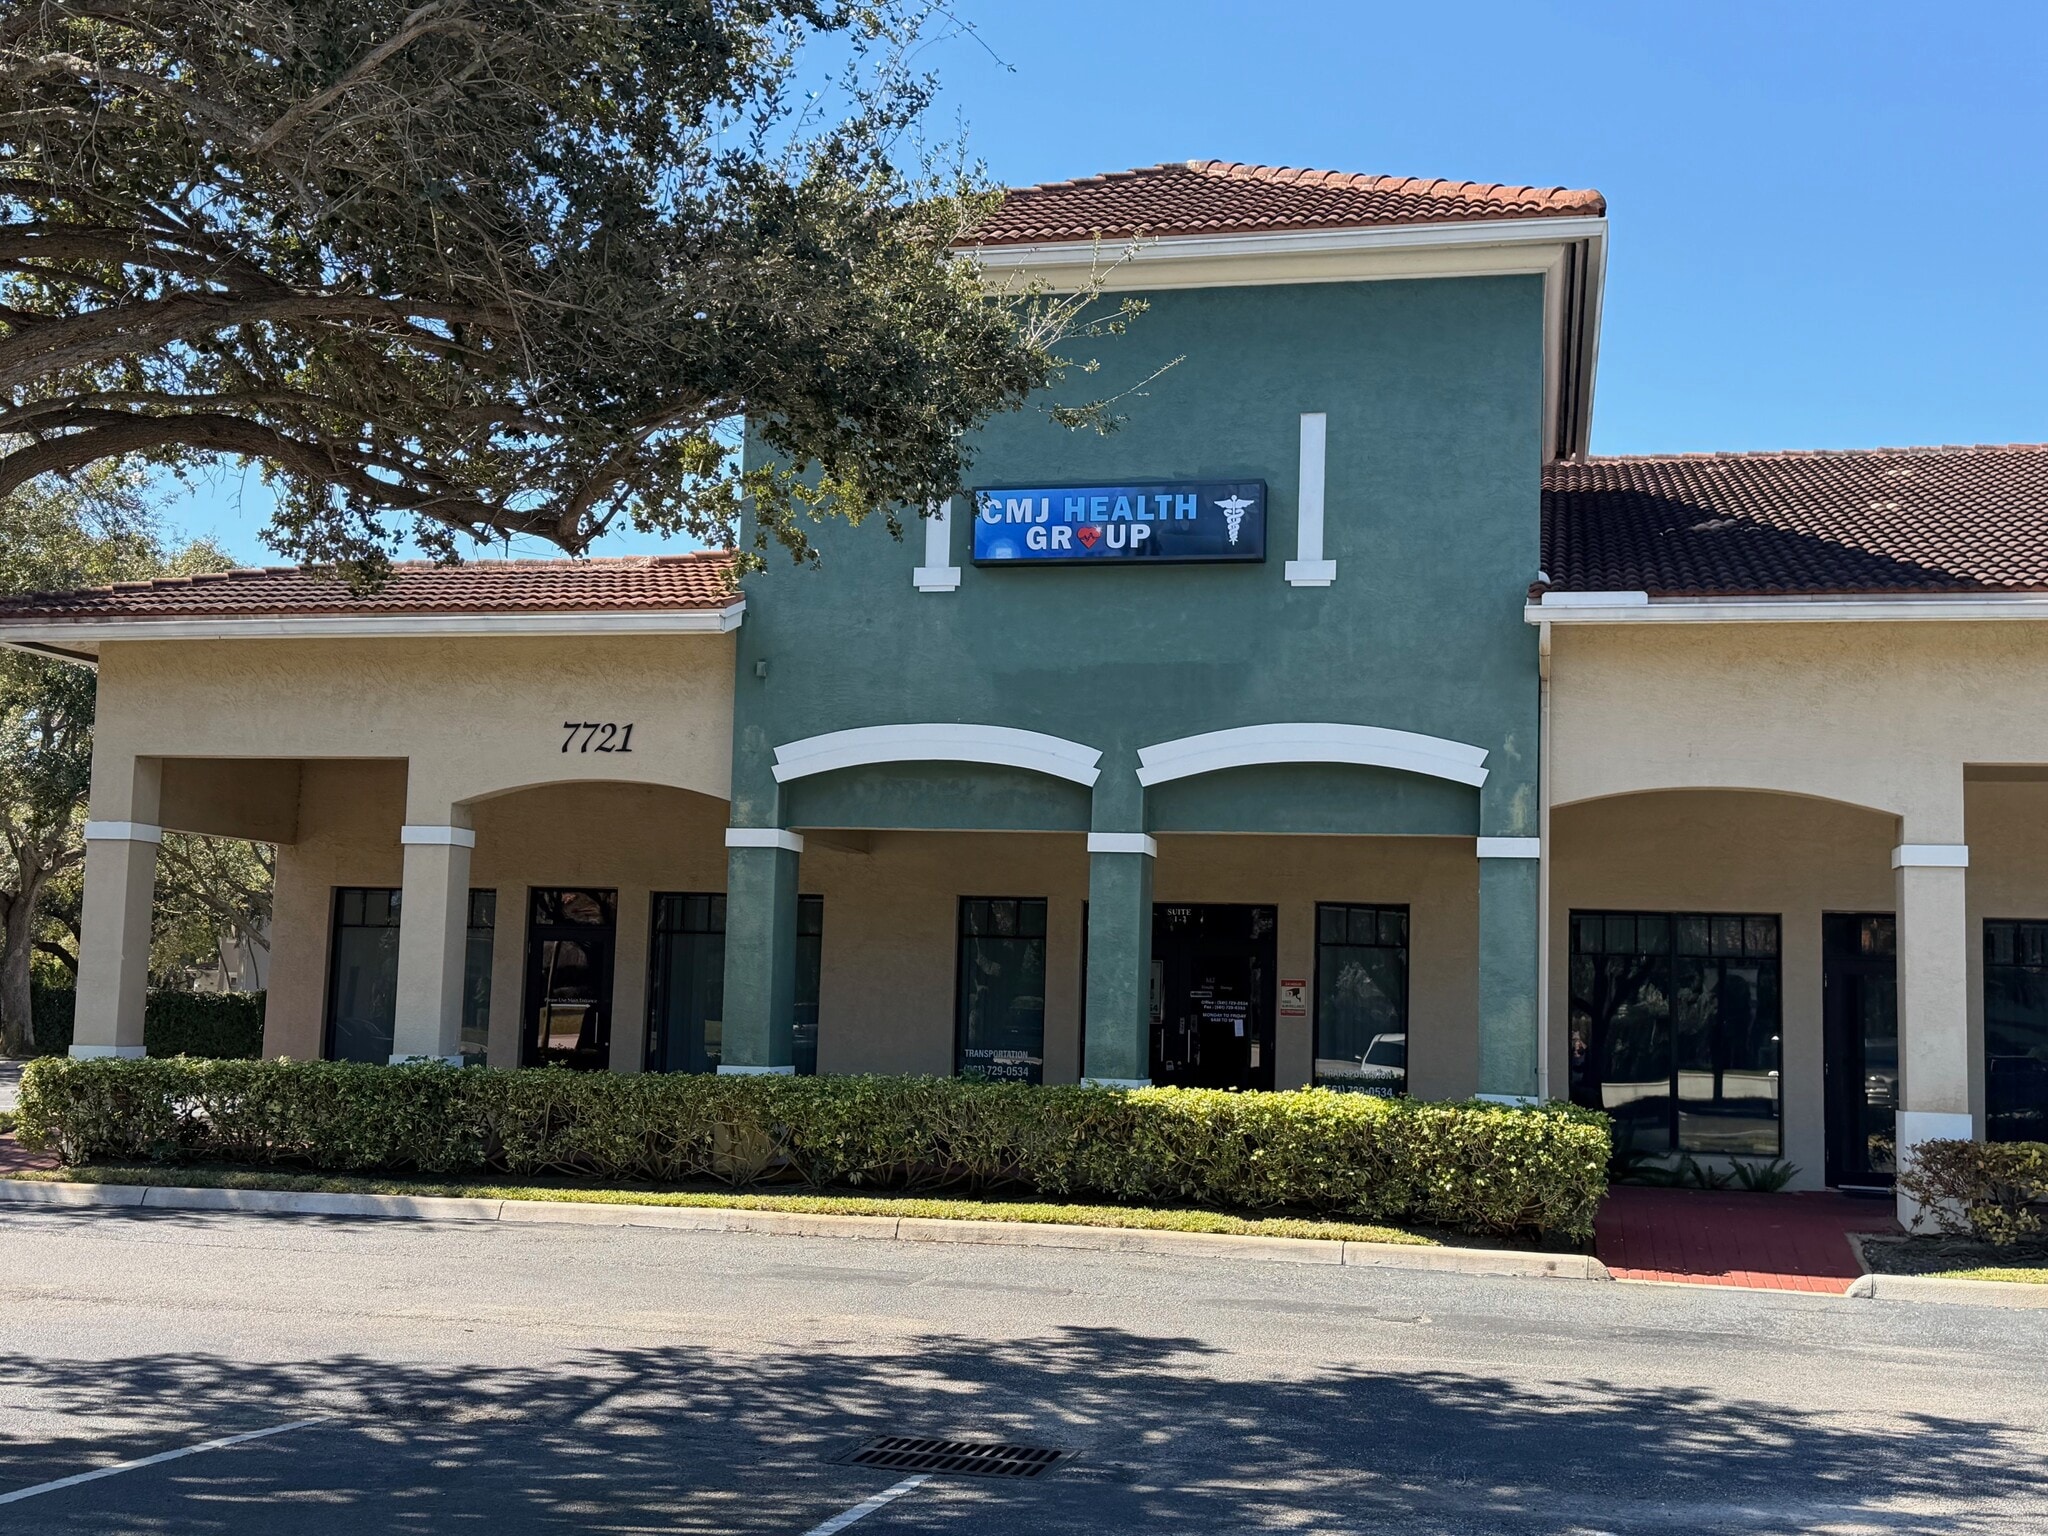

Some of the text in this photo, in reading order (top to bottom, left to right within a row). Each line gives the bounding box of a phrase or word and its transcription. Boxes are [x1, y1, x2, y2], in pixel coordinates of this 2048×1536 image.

[980, 494, 1197, 525] CMJ HEALTH
[561, 721, 633, 753] 7721
[1167, 908, 1192, 916] SUITE
[964, 1048, 1029, 1059] TRANSPORTATION
[986, 1065, 1029, 1077] 729-0534
